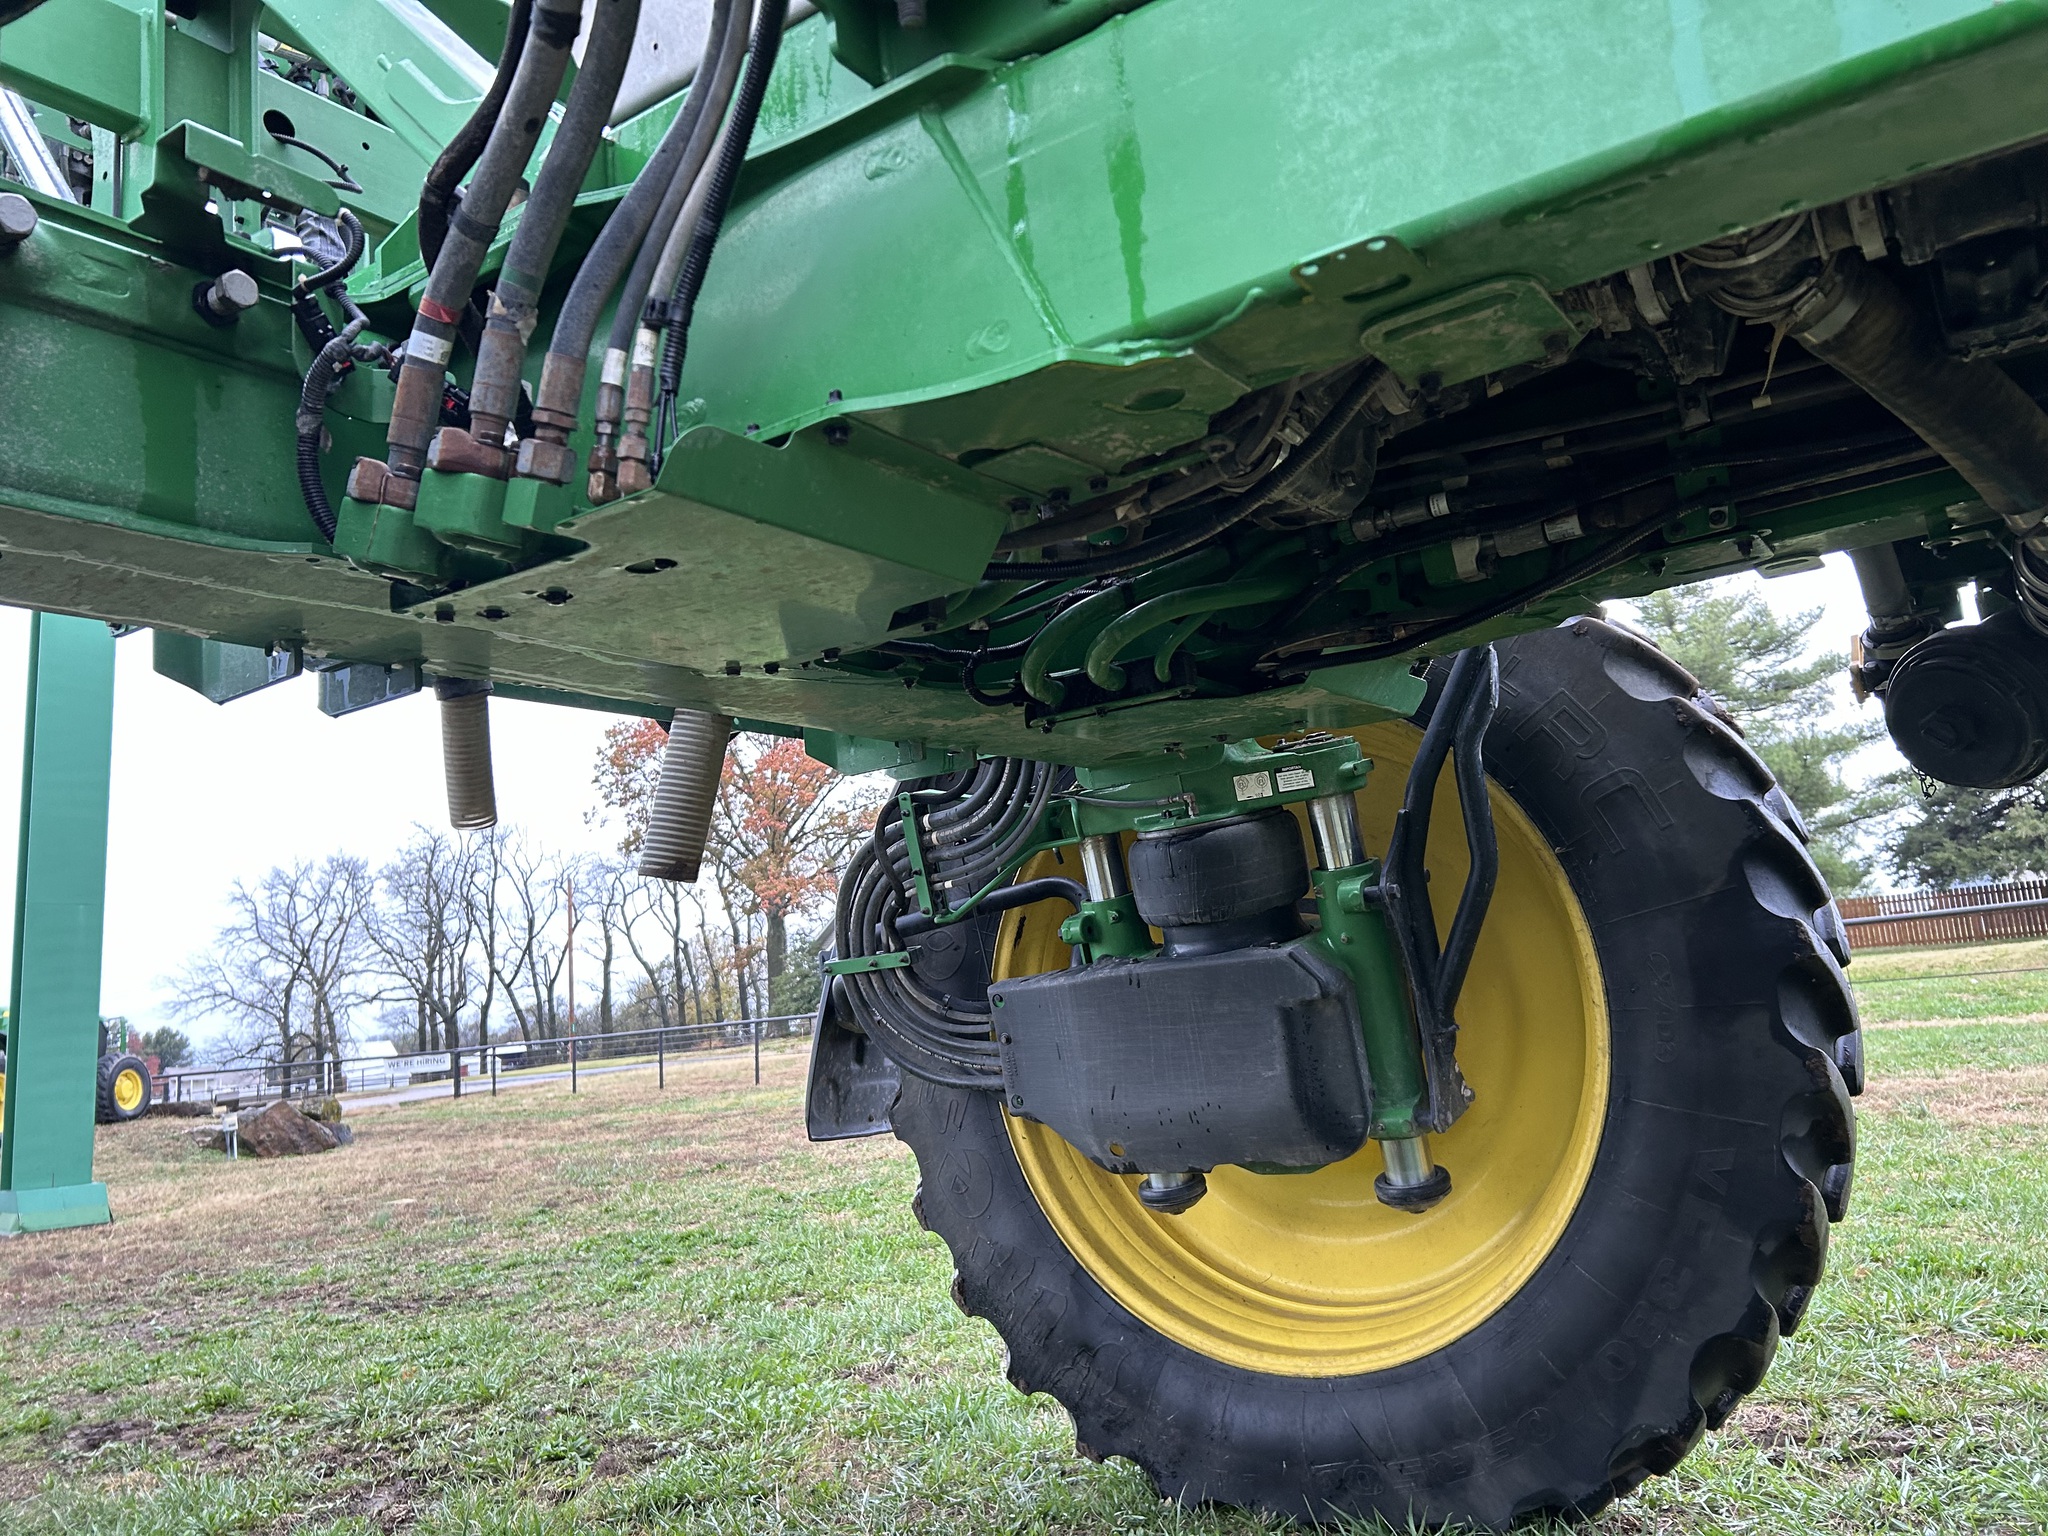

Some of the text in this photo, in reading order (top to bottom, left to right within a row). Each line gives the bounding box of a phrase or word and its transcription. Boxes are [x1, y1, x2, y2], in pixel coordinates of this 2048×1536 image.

[1512, 688, 1674, 855] RC
[387, 1057, 446, 1069] WE'RE HIRING
